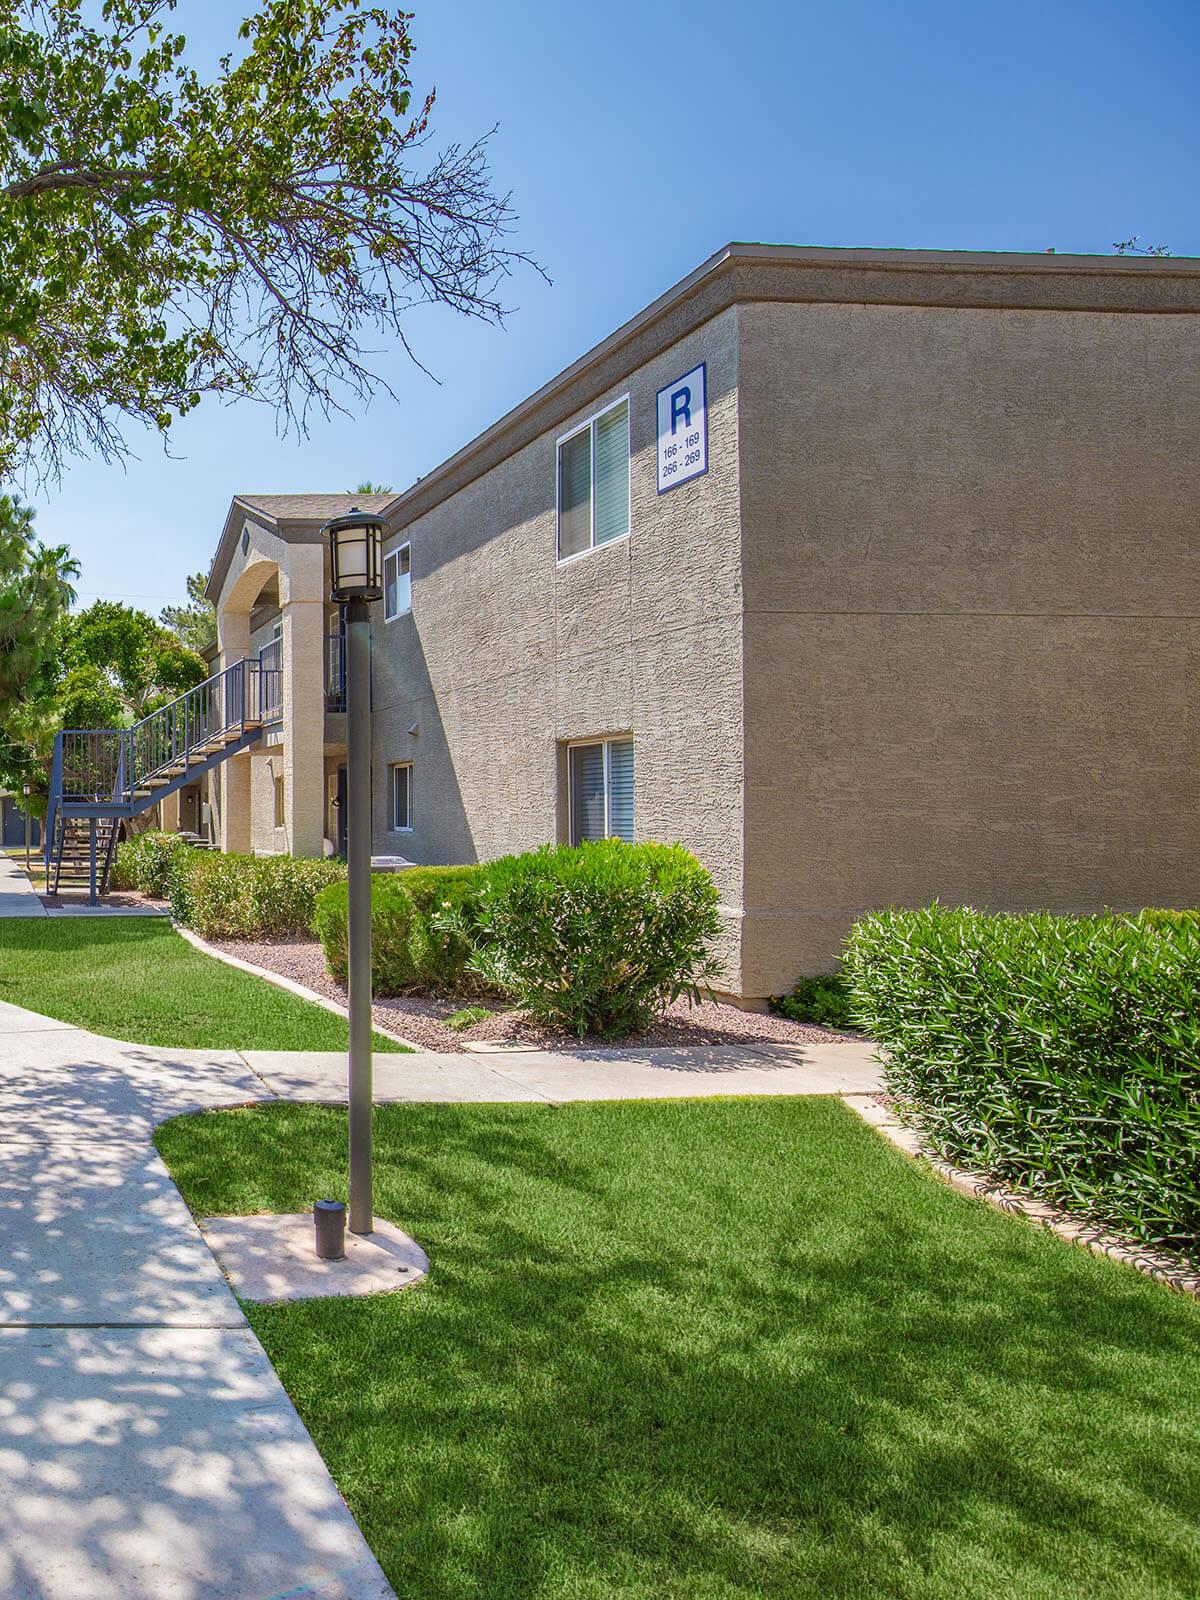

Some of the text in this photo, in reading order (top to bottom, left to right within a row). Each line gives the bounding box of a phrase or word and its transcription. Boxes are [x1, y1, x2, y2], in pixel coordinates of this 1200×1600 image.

[671, 386, 692, 436] R
[663, 443, 678, 460] 166
[685, 431, 700, 449] 169
[662, 461, 678, 478] 266
[684, 449, 701, 467] 269
